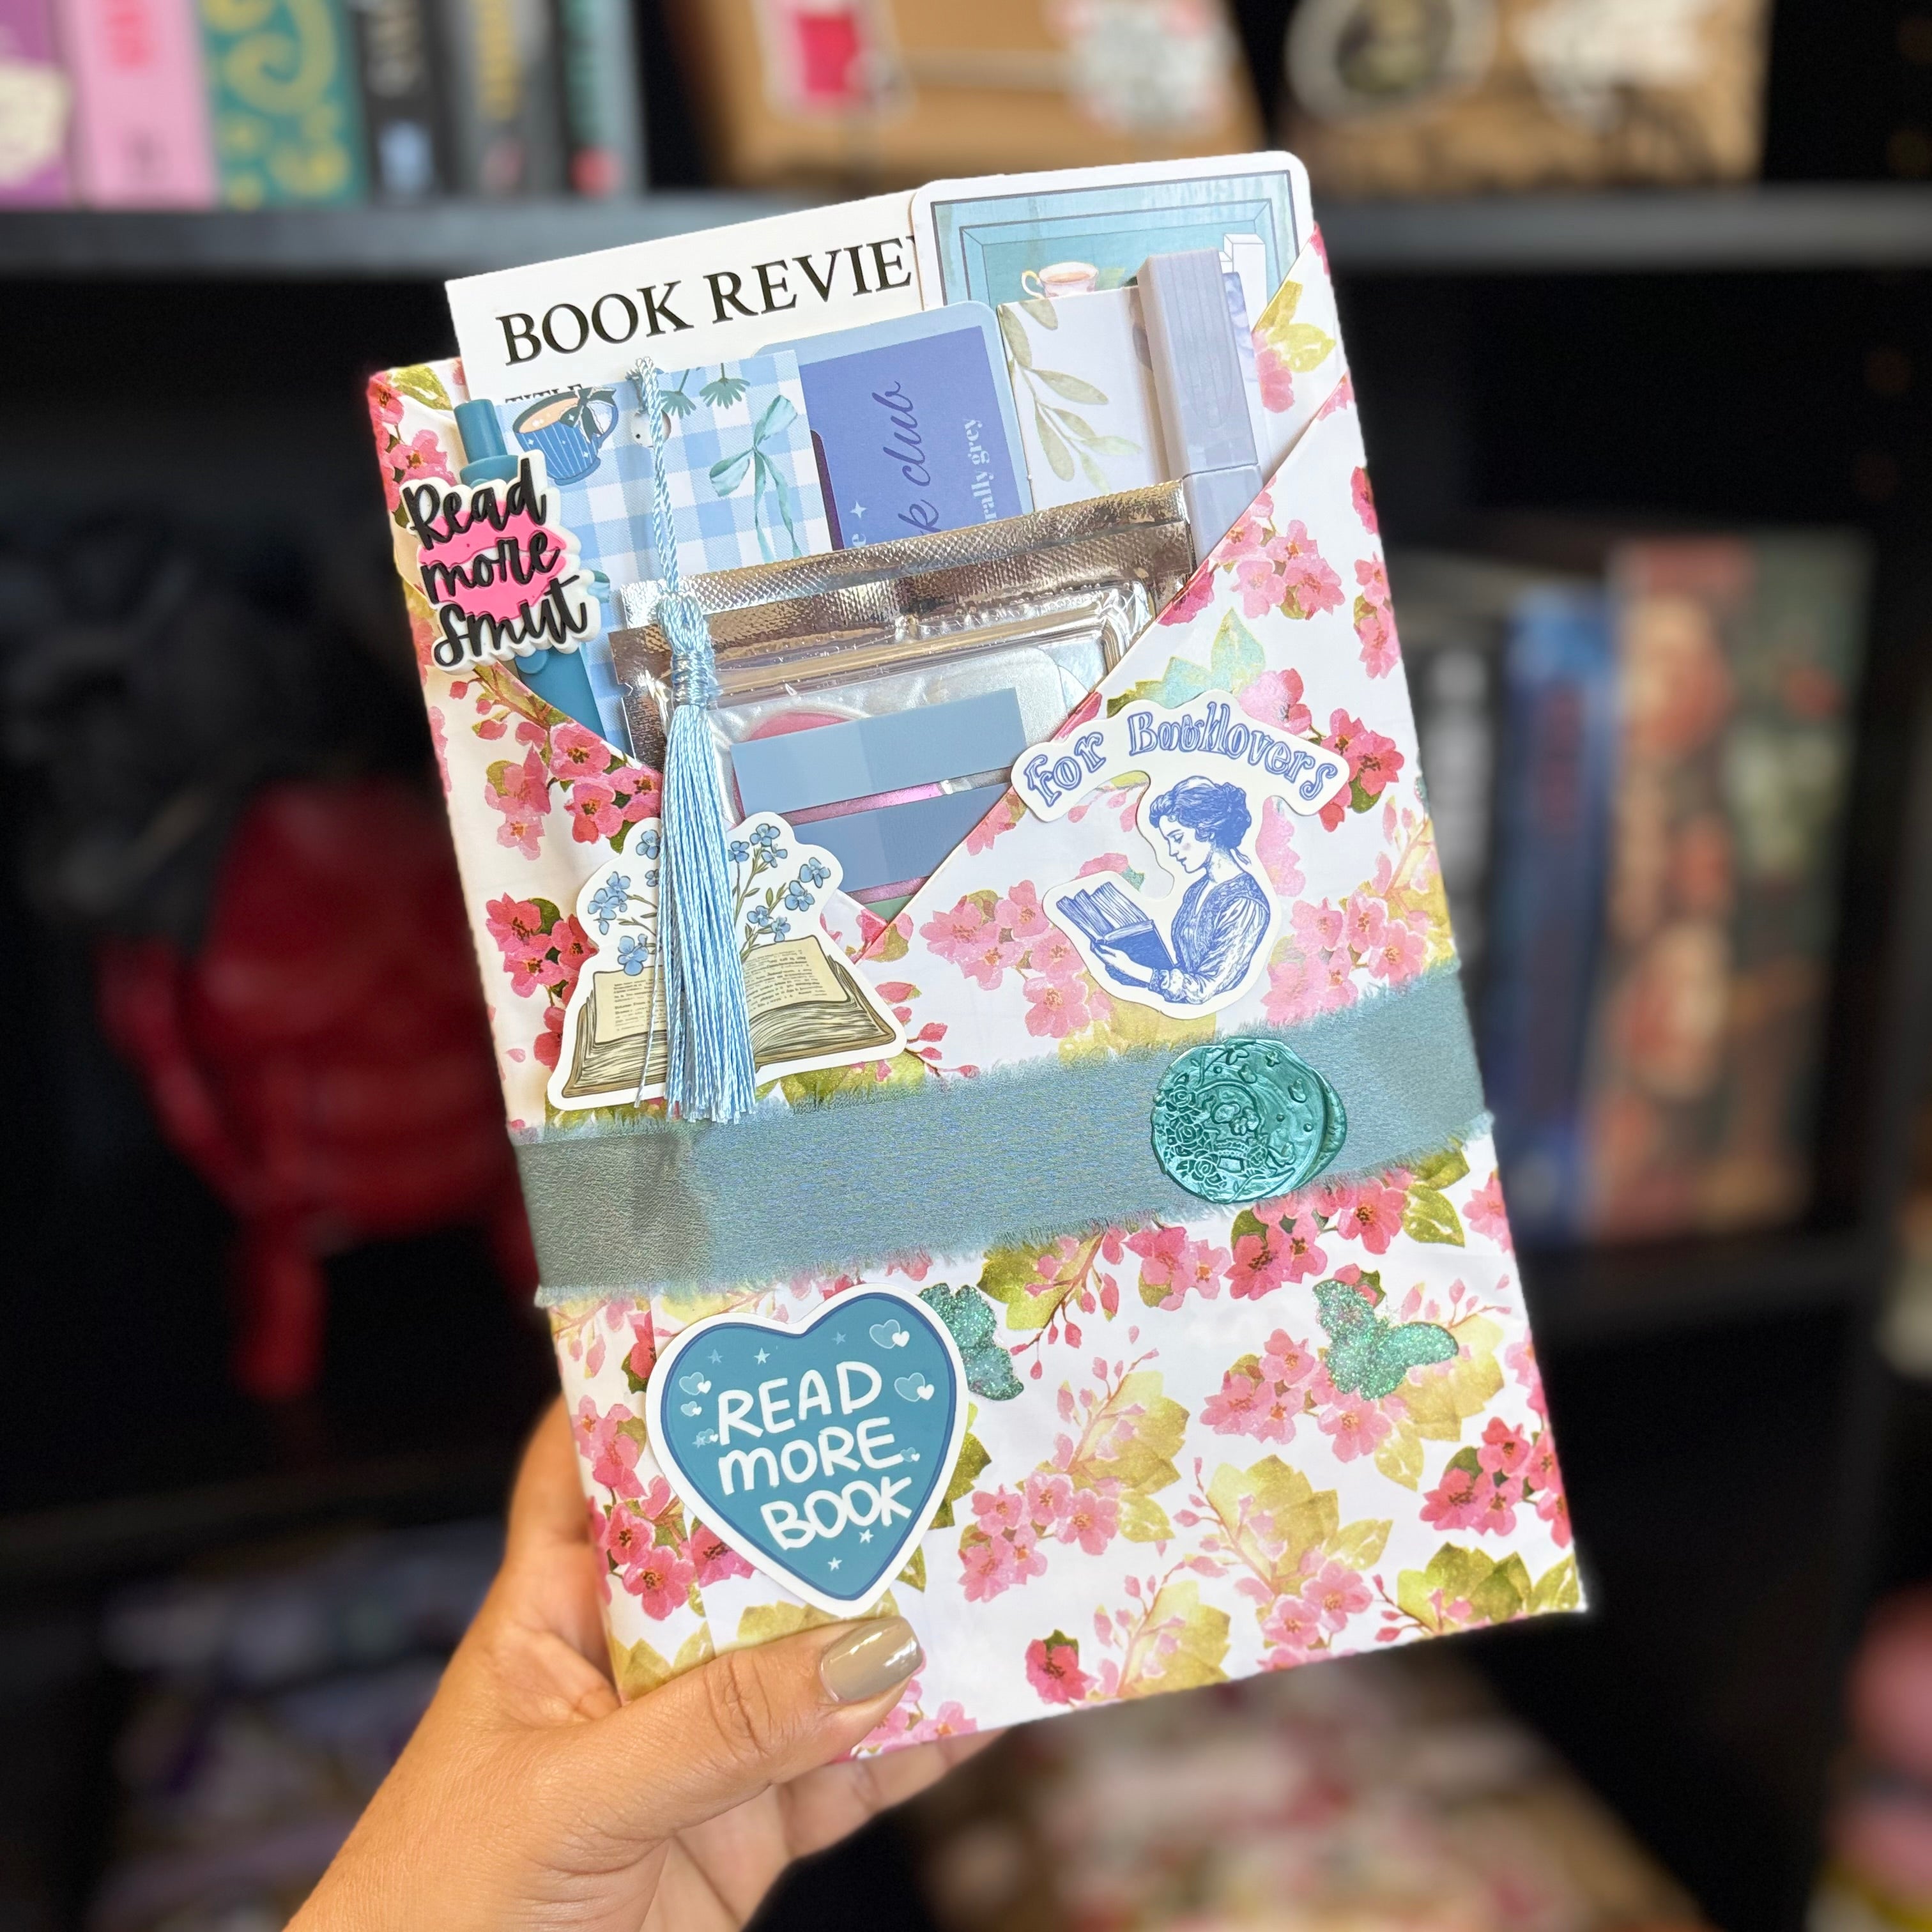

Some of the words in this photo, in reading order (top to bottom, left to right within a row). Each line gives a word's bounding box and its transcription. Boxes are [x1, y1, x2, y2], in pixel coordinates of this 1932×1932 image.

[495, 279, 694, 366] BOOK
[703, 234, 916, 324] REVIE
[871, 380, 931, 487] club
[963, 418, 990, 466] grey
[402, 457, 548, 550] Read
[971, 470, 997, 524] rally
[420, 531, 561, 604] more
[1023, 731, 1107, 808] For
[717, 1361, 882, 1446] READ
[717, 1416, 904, 1496] MORE
[760, 1476, 913, 1551] BOOK
